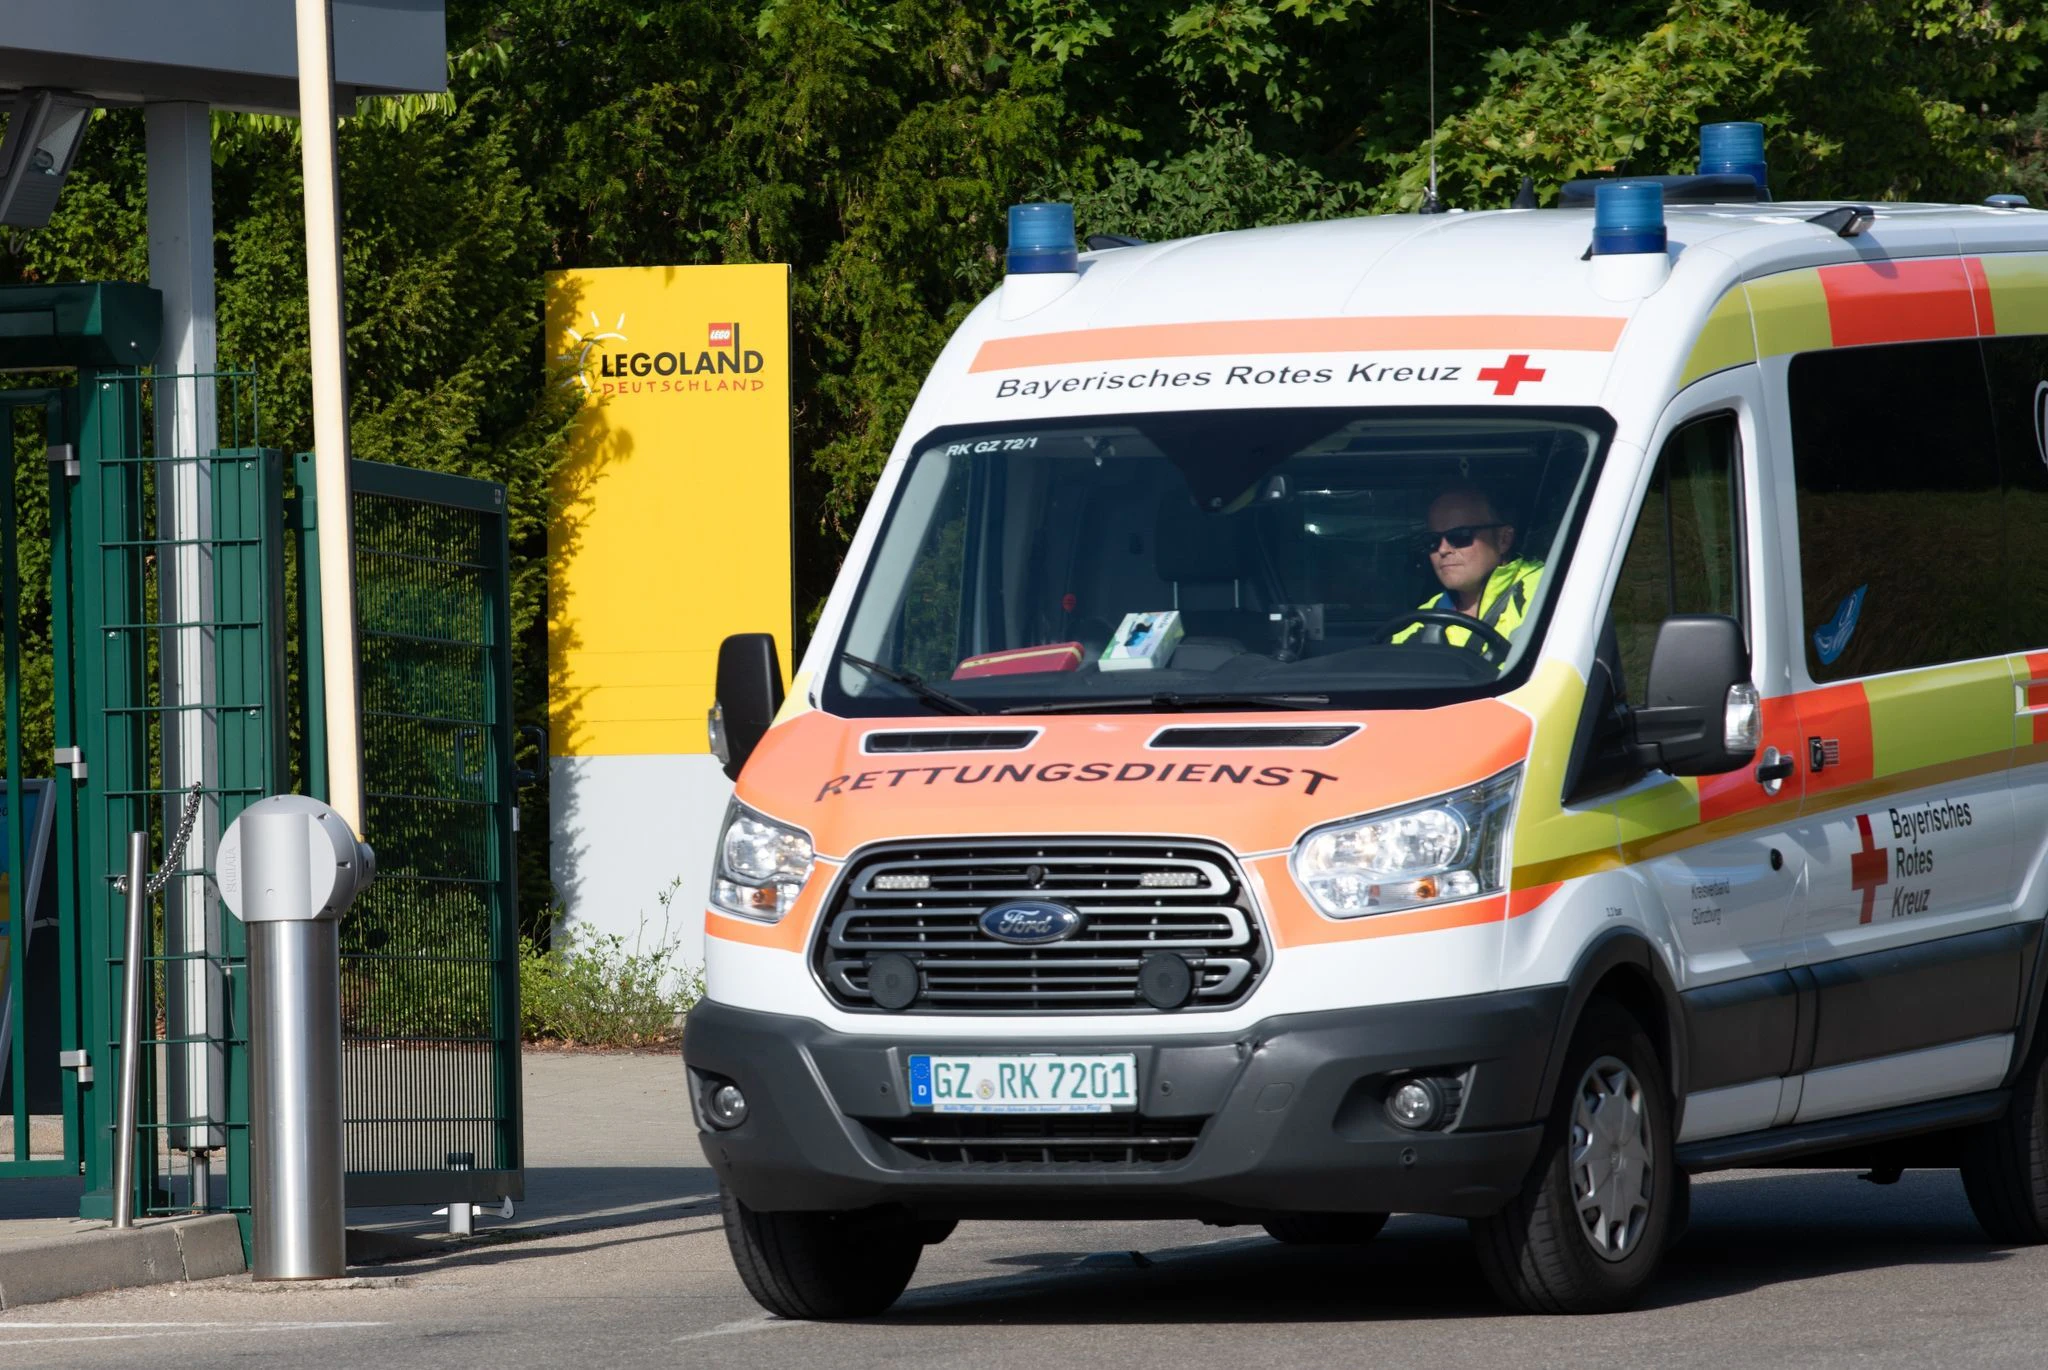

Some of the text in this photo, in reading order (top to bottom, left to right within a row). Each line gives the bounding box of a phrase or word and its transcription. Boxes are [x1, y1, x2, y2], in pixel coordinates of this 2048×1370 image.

[601, 322, 764, 378] LEGOLAND
[709, 329, 731, 341] LEGO
[602, 379, 764, 396] DEUTSCHLAND
[996, 362, 1462, 399] Bayerisches Rotes Kreuz
[945, 437, 1038, 456] RK GZ 72/1
[814, 762, 1338, 802] RETTUNGSDIENST
[1888, 798, 1972, 844] Bayerisches
[1896, 847, 1933, 879] Rotes
[1892, 886, 1931, 918] Kreuz
[998, 909, 1053, 934] Ford
[917, 1062, 1130, 1099] D GZ RK 7201
